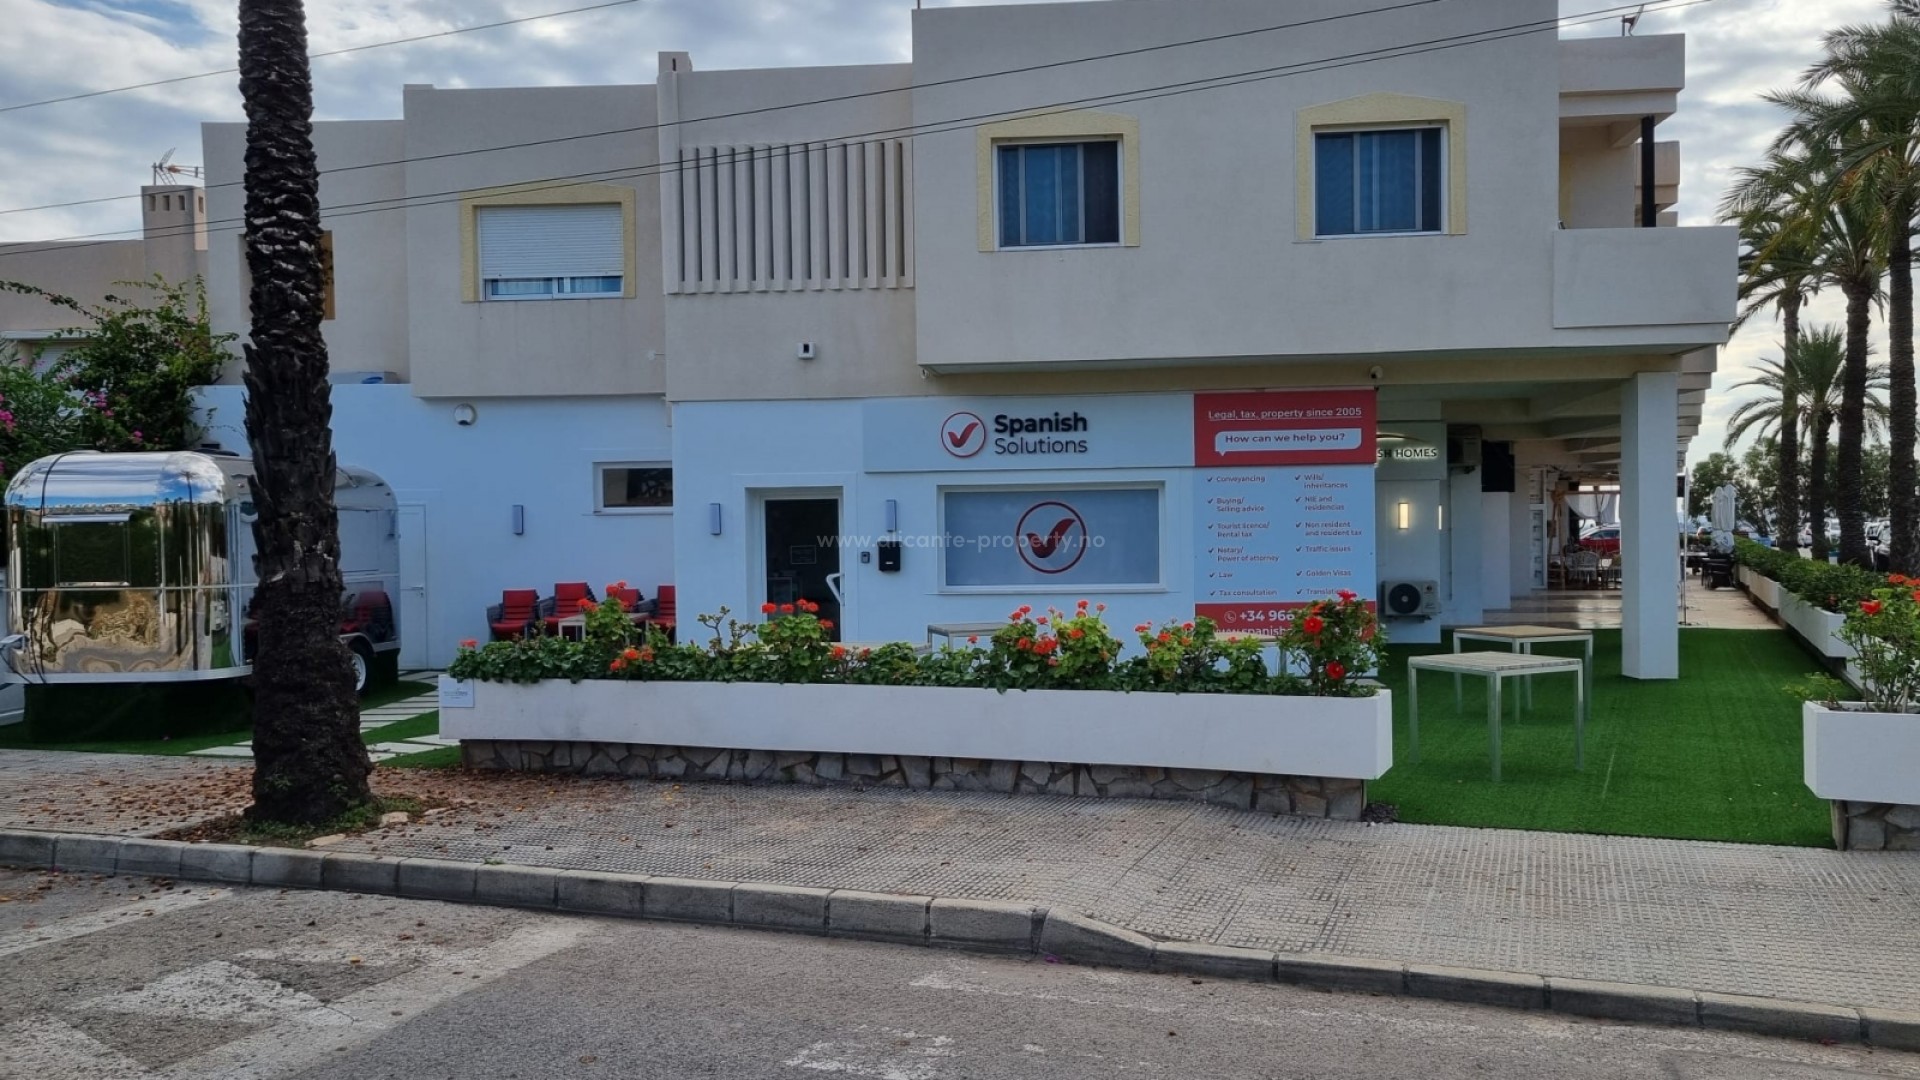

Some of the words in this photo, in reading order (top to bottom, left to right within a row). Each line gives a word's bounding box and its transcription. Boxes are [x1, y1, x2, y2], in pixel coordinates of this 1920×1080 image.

[1208, 410, 1238, 420] Legal,
[1241, 410, 1259, 419] tax,
[1261, 409, 1303, 419] property
[1306, 408, 1333, 416] since
[1336, 407, 1362, 416] 2005
[994, 412, 1088, 437] Spanish
[1225, 435, 1249, 443] How
[1252, 435, 1271, 443] can
[1293, 433, 1316, 444] help
[1319, 432, 1345, 444] you?
[994, 437, 1088, 455] Solutions
[1377, 448, 1392, 458] SH
[1396, 448, 1437, 458] HOMES
[1216, 475, 1266, 483] Conveyancing
[1216, 496, 1245, 504] Buying/
[1218, 546, 1244, 554] Notary/
[1239, 610, 1265, 622] +34
